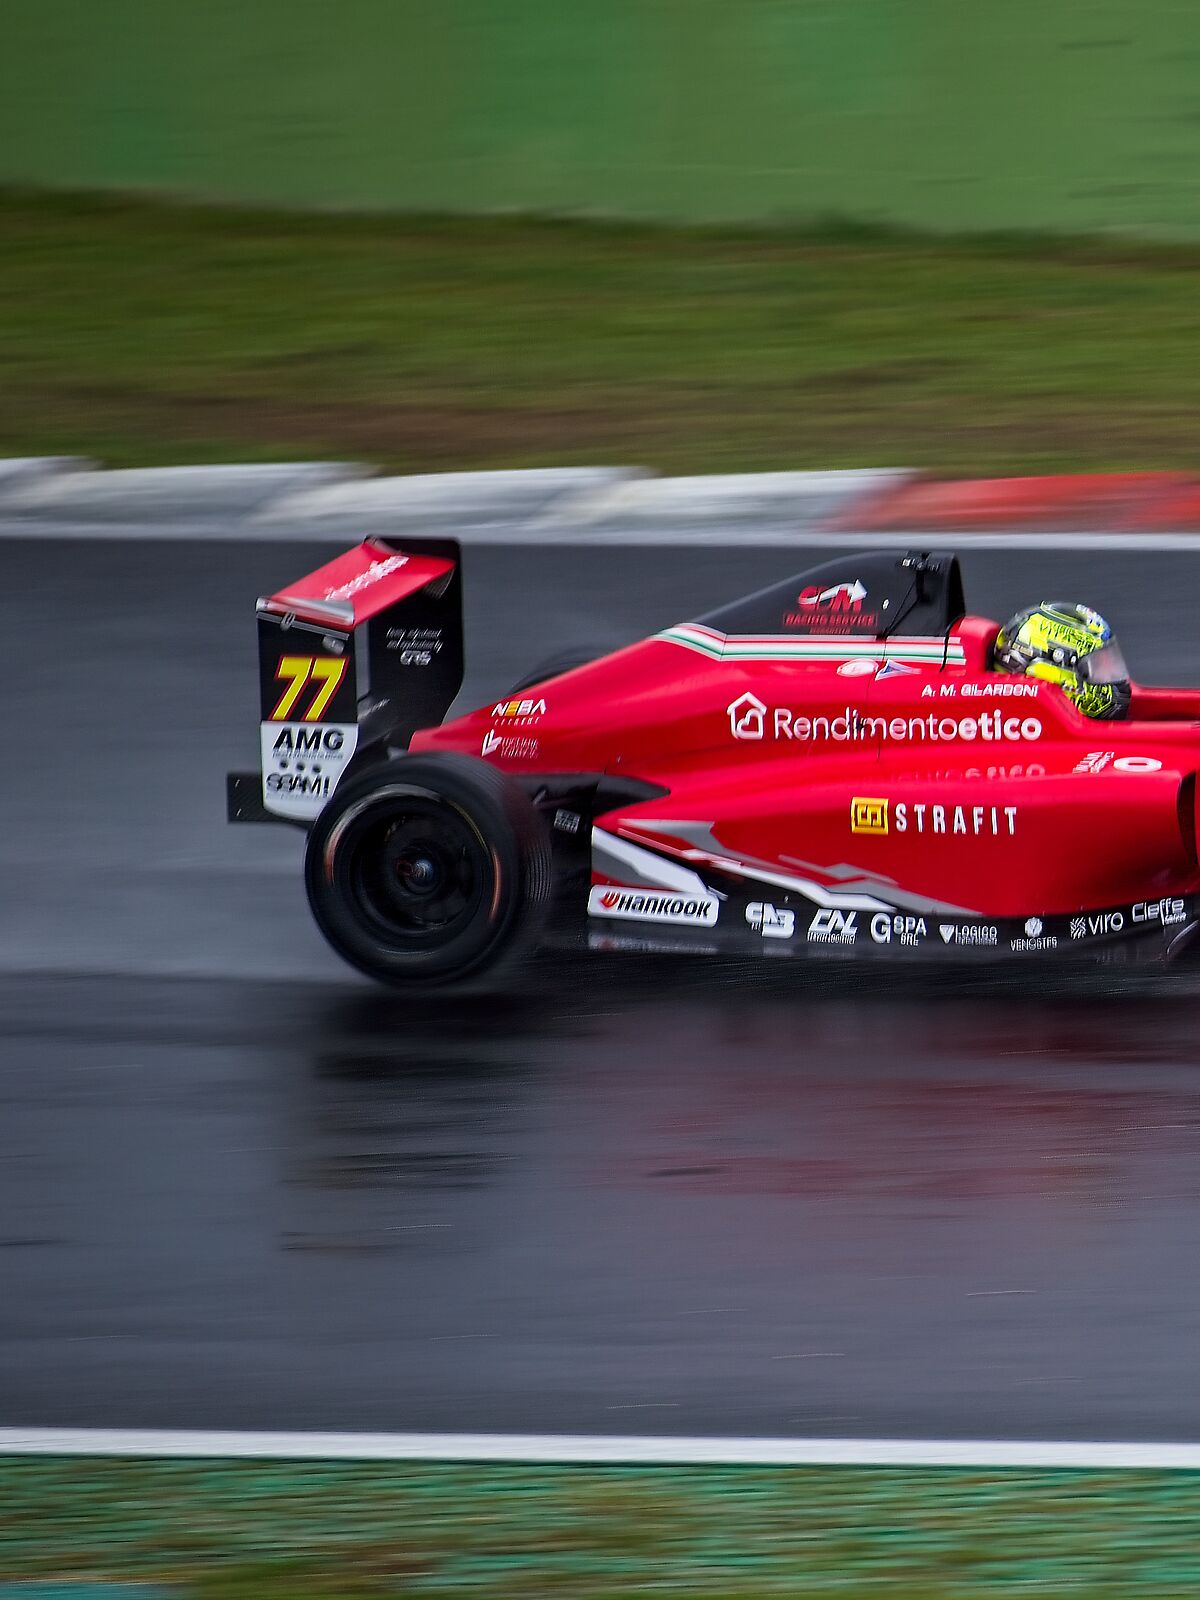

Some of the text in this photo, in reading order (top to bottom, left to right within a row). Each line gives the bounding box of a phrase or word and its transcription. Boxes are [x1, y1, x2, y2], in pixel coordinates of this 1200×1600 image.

[268, 655, 350, 721] 77
[273, 727, 344, 752] AMG
[895, 802, 1017, 836] STRAFIT
